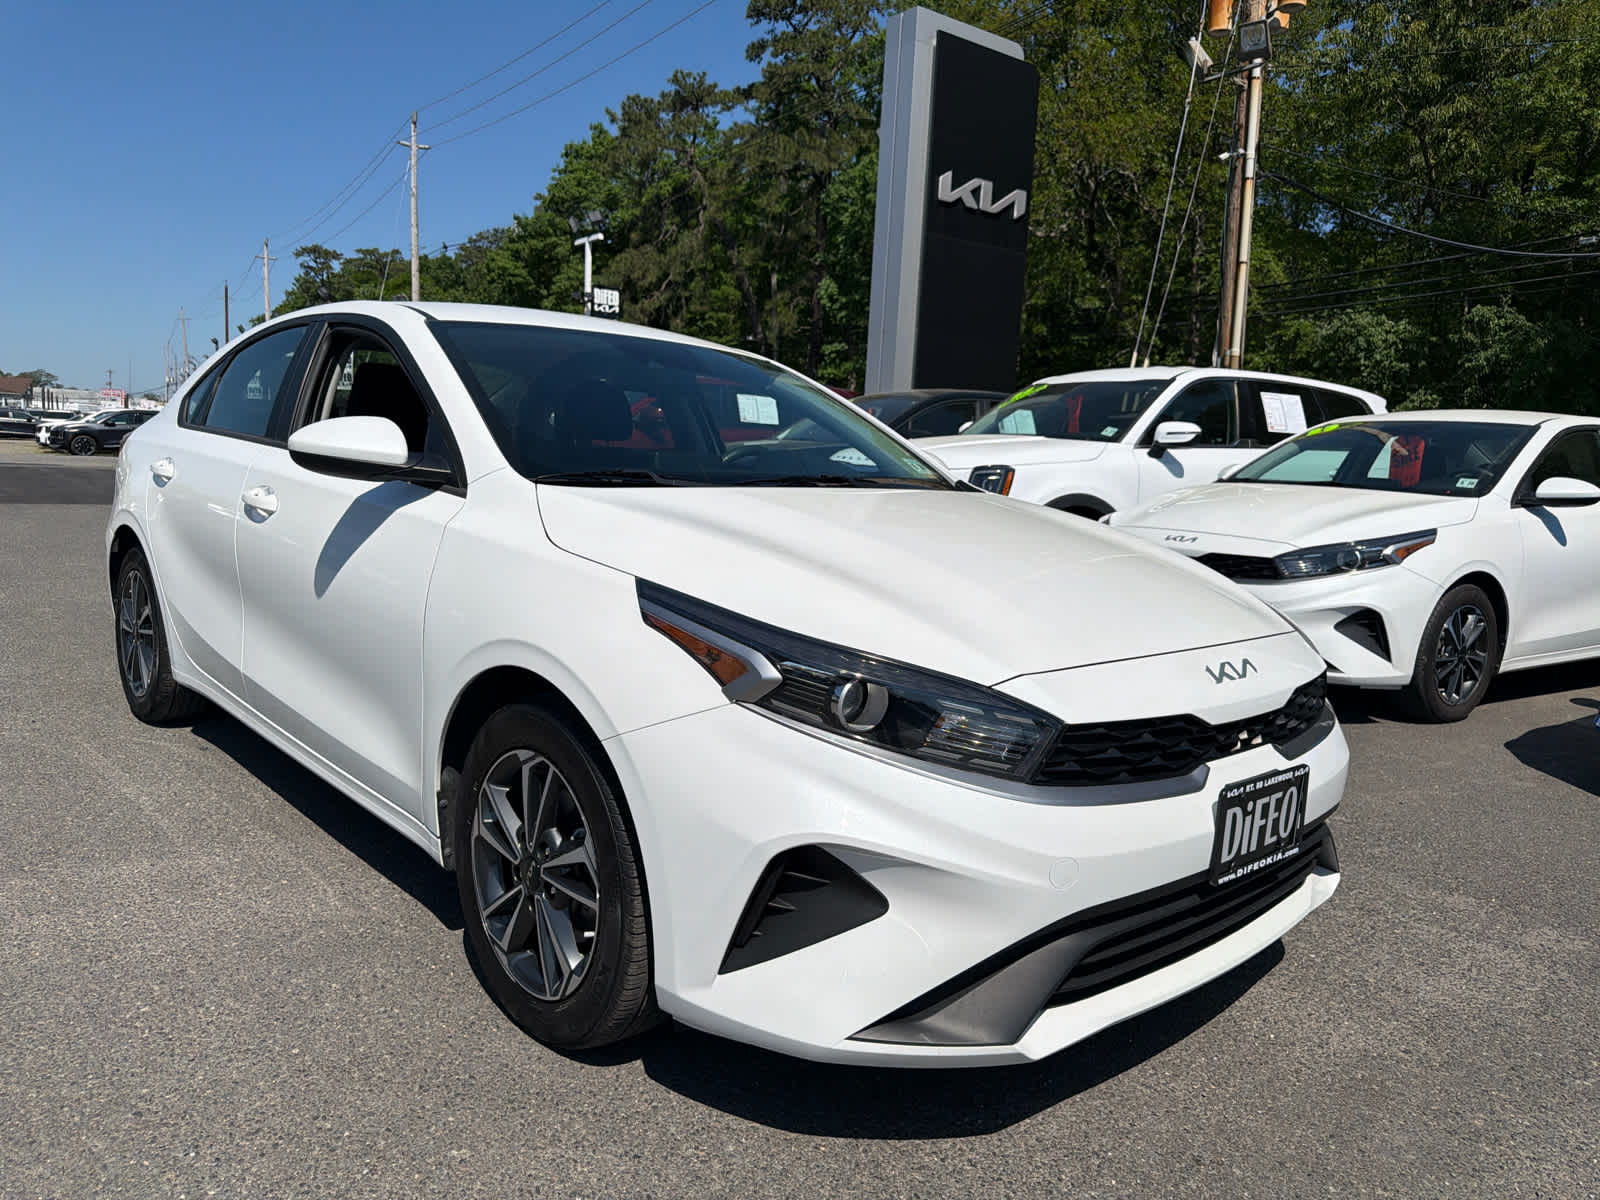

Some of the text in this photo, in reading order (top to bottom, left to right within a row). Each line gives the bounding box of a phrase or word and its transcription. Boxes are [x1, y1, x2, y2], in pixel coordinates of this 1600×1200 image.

[938, 170, 1027, 219] KIA
[1164, 534, 1199, 543] KIA
[1205, 658, 1258, 685] KIA
